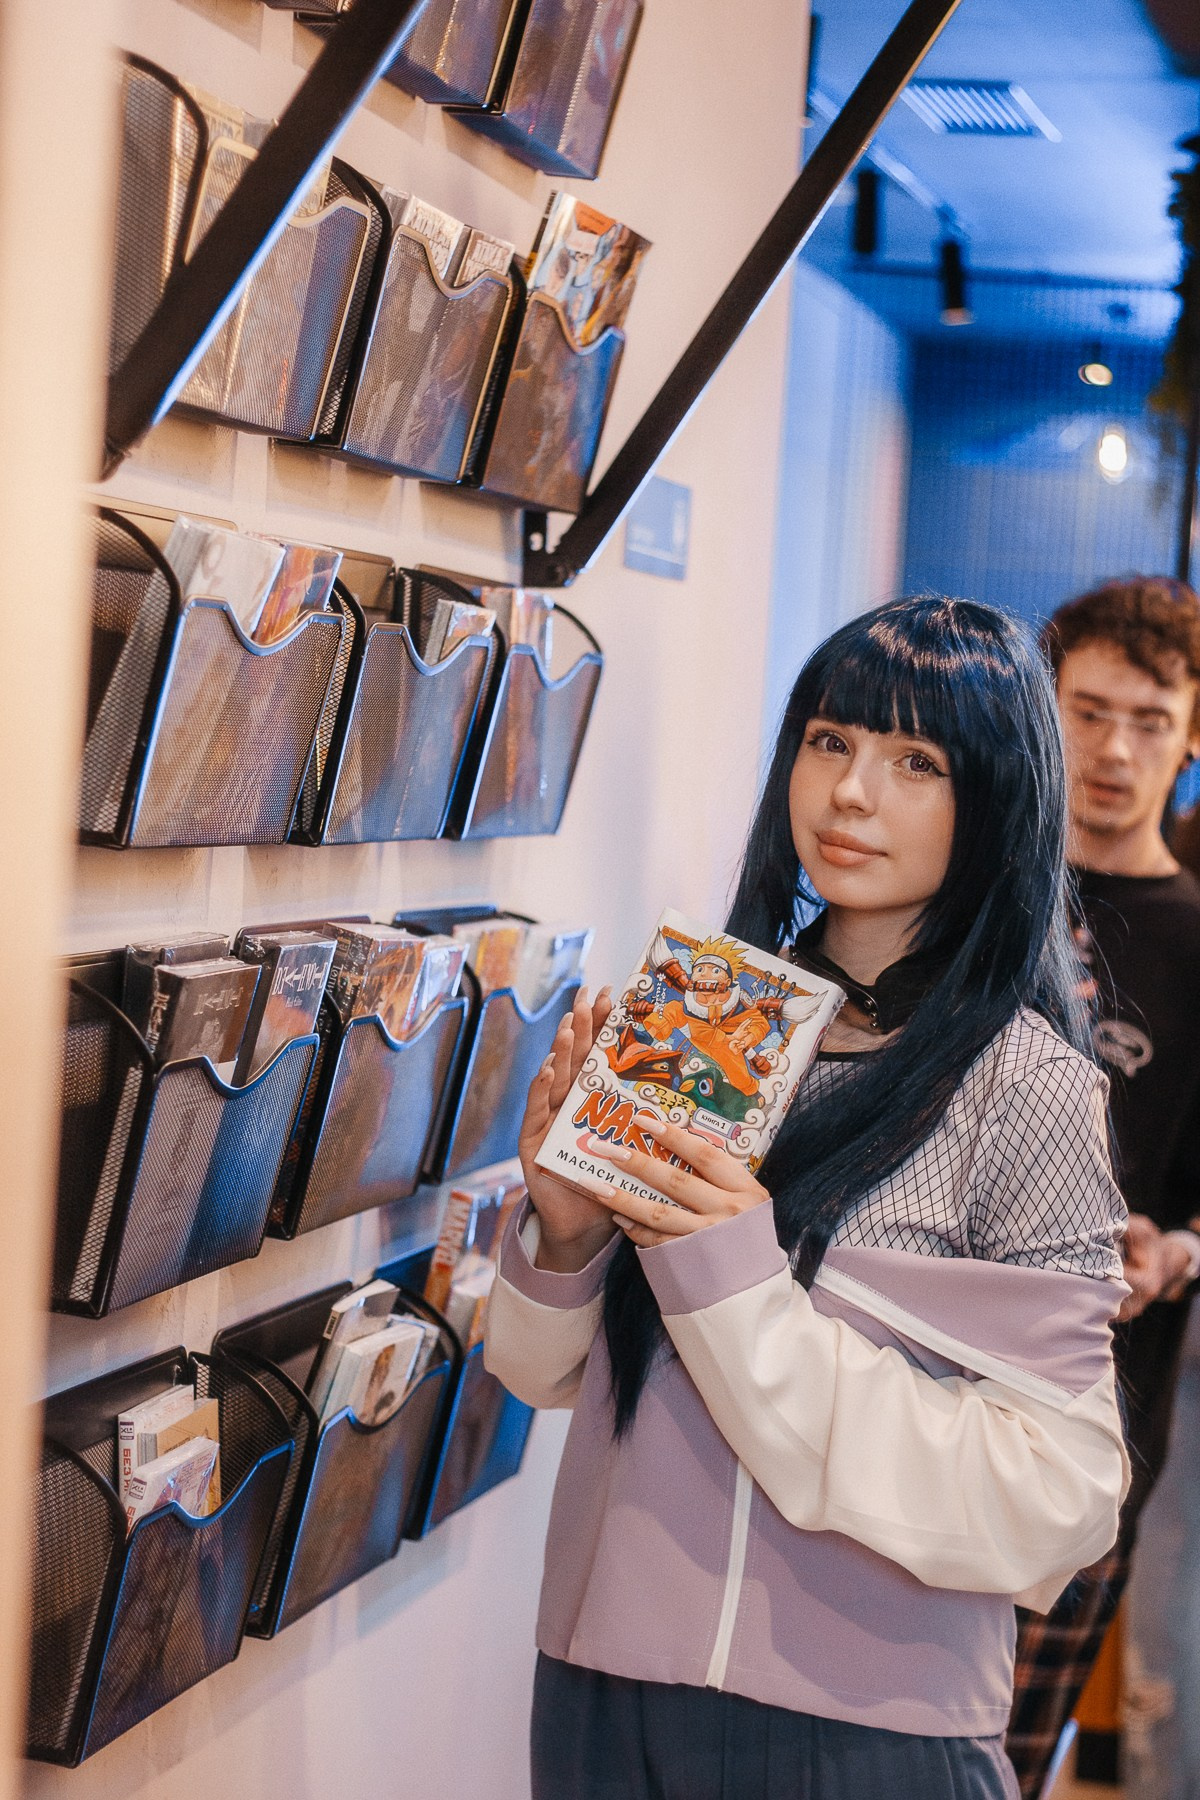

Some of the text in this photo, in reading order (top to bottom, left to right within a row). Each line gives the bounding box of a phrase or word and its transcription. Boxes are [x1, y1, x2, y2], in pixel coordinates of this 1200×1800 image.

[701, 1114, 726, 1130] КНИГА 1
[556, 1149, 615, 1183] МАСАСИ
[123, 1448, 131, 1476] БЕЗ
